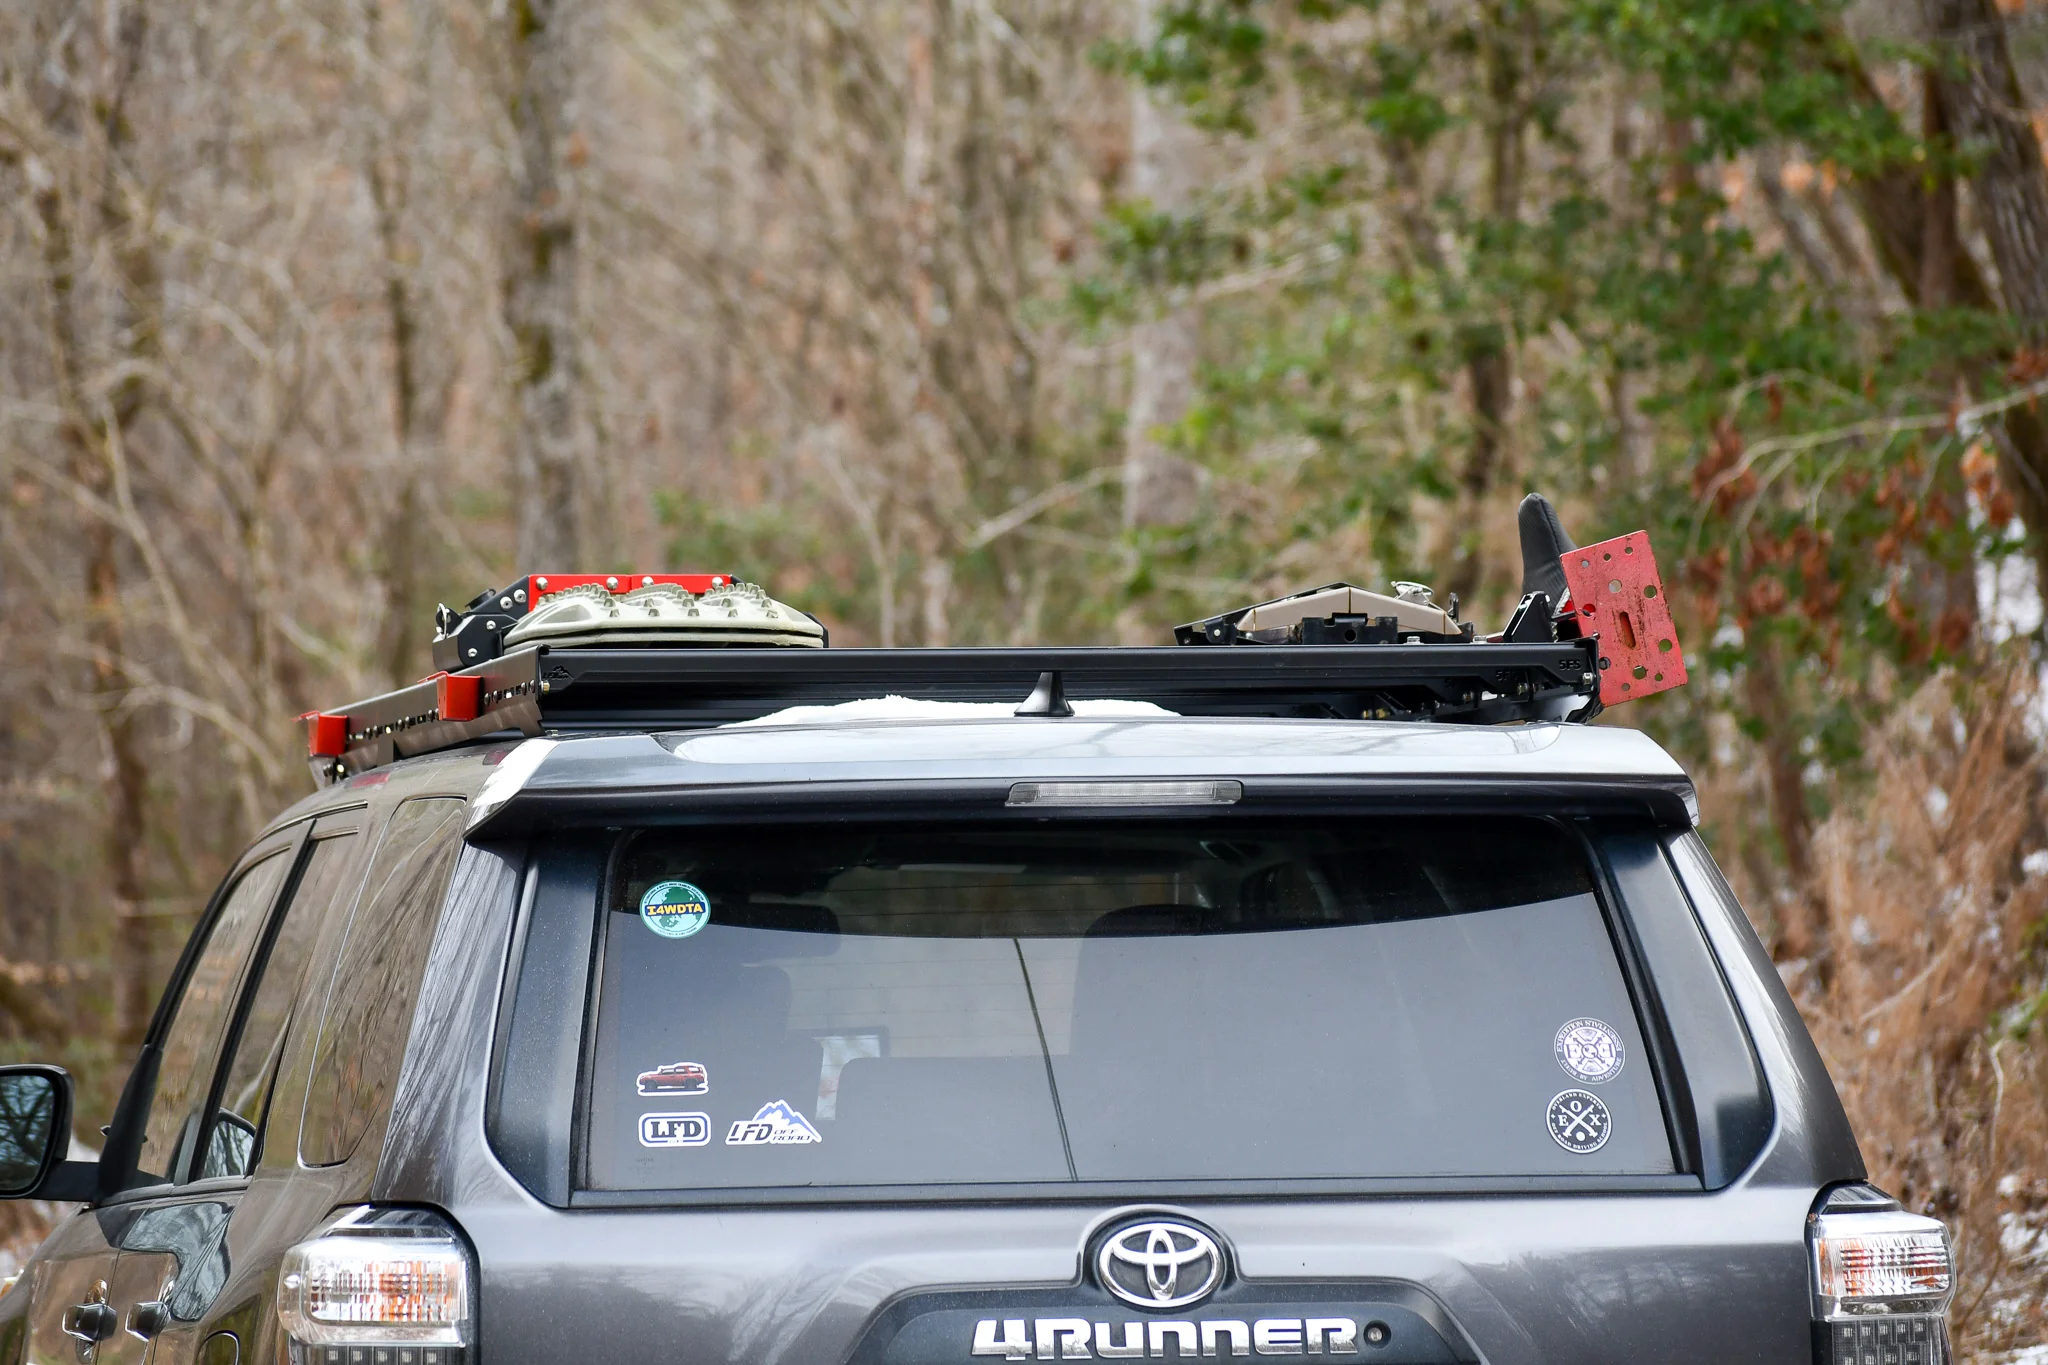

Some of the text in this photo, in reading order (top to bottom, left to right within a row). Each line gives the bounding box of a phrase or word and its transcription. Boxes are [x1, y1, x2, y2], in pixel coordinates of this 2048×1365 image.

[646, 903, 704, 916] I4WDTA
[1556, 1020, 1583, 1052] EXPEDITION
[1591, 1057, 1621, 1081] ADVENTURE
[1551, 1092, 1602, 1110] OVERLAND EXPERTS
[650, 1120, 702, 1138] LFD
[728, 1123, 773, 1142] LFD
[1558, 1134, 1572, 1147] ROAD
[1572, 1140, 1597, 1149] DRIVING
[1597, 1122, 1607, 1142] SCHOOL
